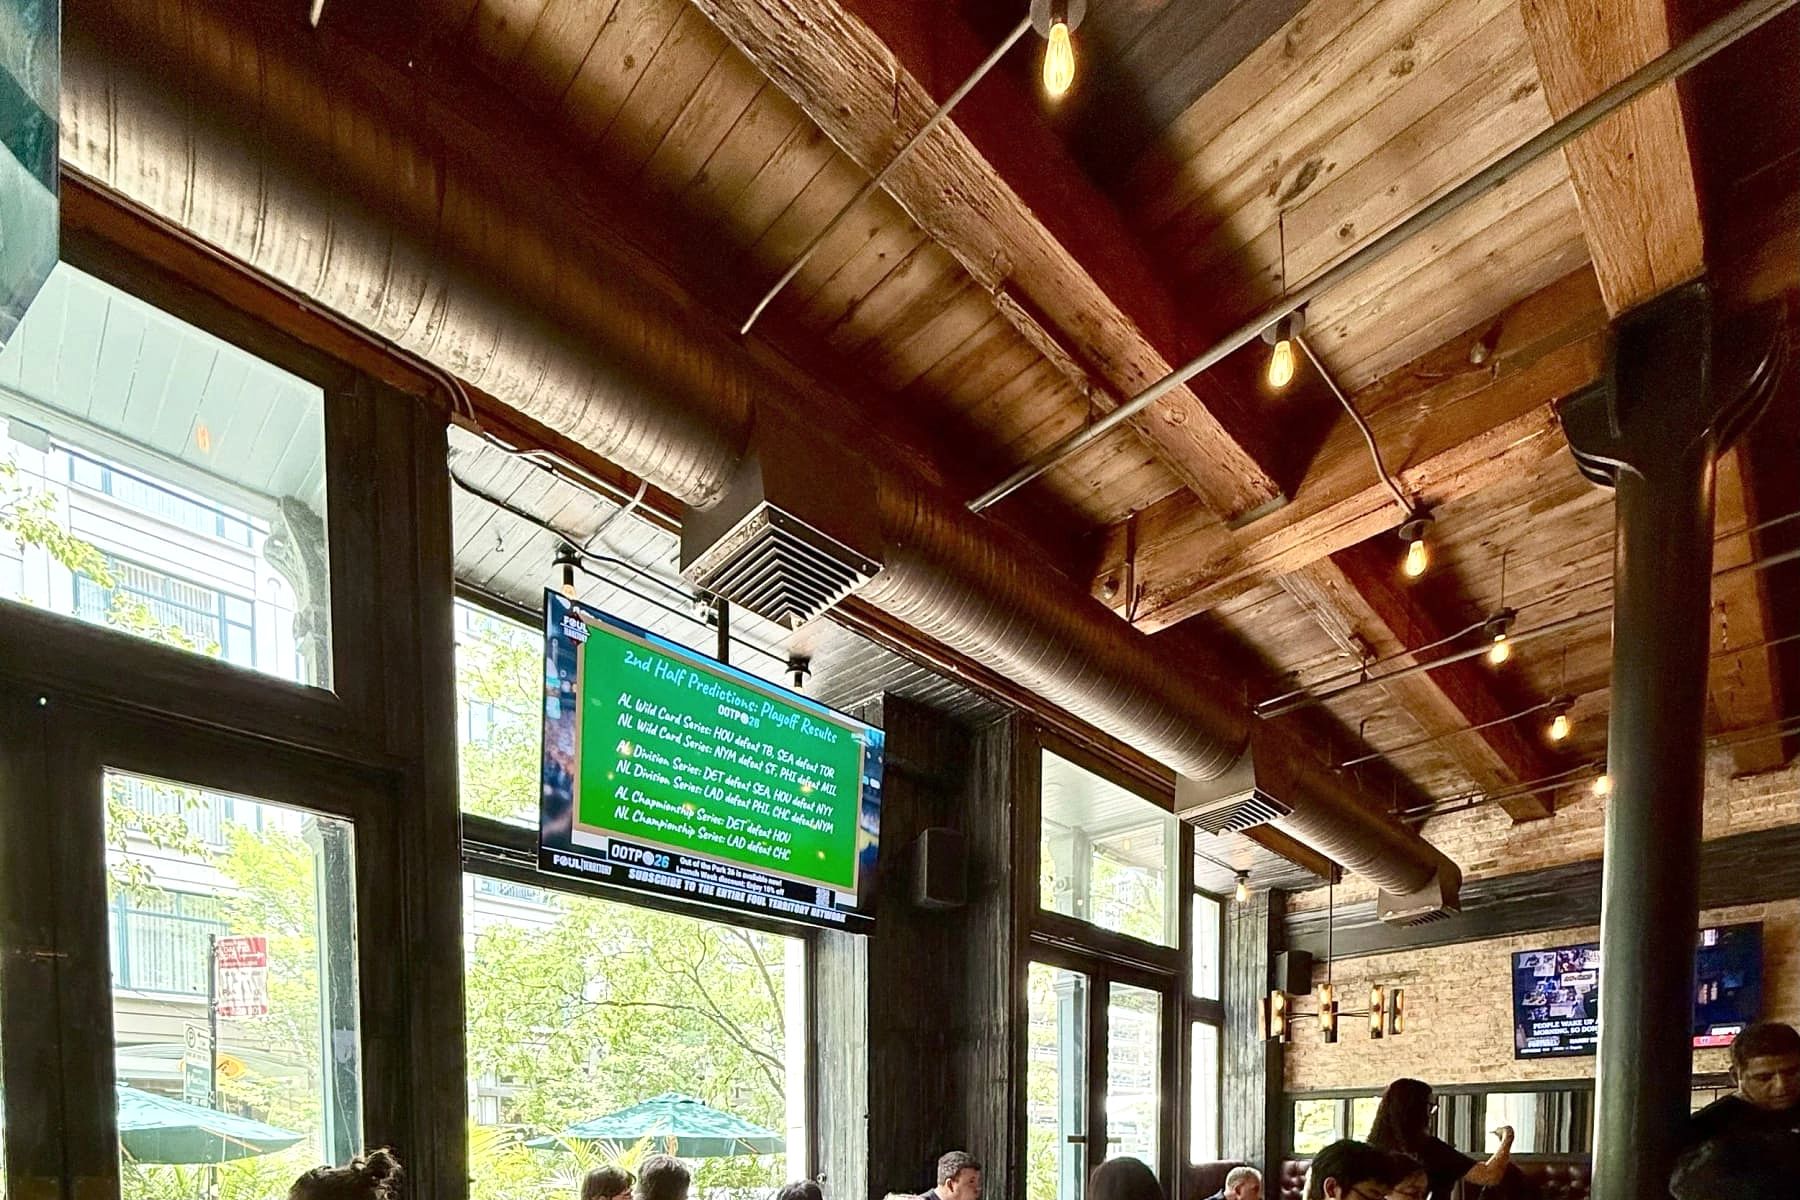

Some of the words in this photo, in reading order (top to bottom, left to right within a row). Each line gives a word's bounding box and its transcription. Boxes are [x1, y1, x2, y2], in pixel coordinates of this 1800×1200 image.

[624, 651, 653, 672] 2nd
[655, 659, 687, 687] Half
[688, 673, 758, 712] Predictions:
[761, 702, 800, 730] Playoff
[800, 717, 838, 743] Results
[617, 692, 632, 708] AL
[635, 699, 658, 716] Wild
[658, 706, 682, 726] Card
[683, 715, 712, 735] Series:
[713, 726, 734, 743] HOU
[735, 736, 760, 753] defeat
[762, 743, 774, 758] TB,
[777, 749, 794, 765] SEA
[795, 757, 818, 775] defeat
[819, 765, 835, 778] TOR
[617, 713, 633, 729] NL
[636, 719, 659, 736] Wild
[659, 726, 682, 744] Card
[683, 735, 712, 753] Series:
[714, 745, 736, 763] NYM
[738, 754, 763, 771] defeat
[764, 762, 778, 777] SF,
[779, 767, 797, 783] PHI
[797, 776, 820, 791] defeat
[820, 782, 837, 796] MIL
[616, 739, 631, 755] AL
[633, 744, 670, 766] Division
[672, 757, 702, 776] Series:
[703, 766, 725, 783] DET
[725, 775, 751, 791] defeat
[773, 789, 792, 804] HOU
[792, 797, 815, 811] defeat
[816, 803, 834, 816] NYY
[616, 760, 631, 775] NL
[633, 763, 670, 785] Division
[673, 776, 702, 794] Series:
[703, 785, 724, 800] LAD
[725, 792, 752, 809] defeat
[772, 806, 791, 821] CHC
[791, 813, 816, 829] defeat
[815, 819, 834, 834] NYM
[614, 805, 629, 820] NL
[632, 809, 695, 838] Championship
[697, 826, 726, 843] Series:
[726, 834, 746, 849] LAD
[747, 840, 772, 856] defeat
[772, 846, 791, 861] CHC
[615, 785, 629, 801] AL
[696, 808, 725, 825] Series:
[726, 816, 746, 832] DET
[747, 823, 772, 839] defeat
[772, 829, 791, 843] HOU
[553, 854, 581, 869] FOUL
[675, 865, 700, 877] Launch
[746, 881, 762, 892] Enjoy
[679, 856, 692, 866] Out
[693, 860, 700, 868] of
[700, 861, 711, 871] the
[711, 864, 726, 874] Park
[628, 868, 682, 889] SUBSCRIBE
[684, 881, 696, 892] TO
[698, 883, 715, 896] THE
[716, 886, 746, 902] ENTIRE
[746, 893, 767, 907] FOUL
[769, 898, 810, 915] TERRITORY
[1533, 1021, 1560, 1029] PEOPLE
[1561, 1019, 1582, 1027] WAKE
[1533, 1027, 1569, 1036] MORNING,
